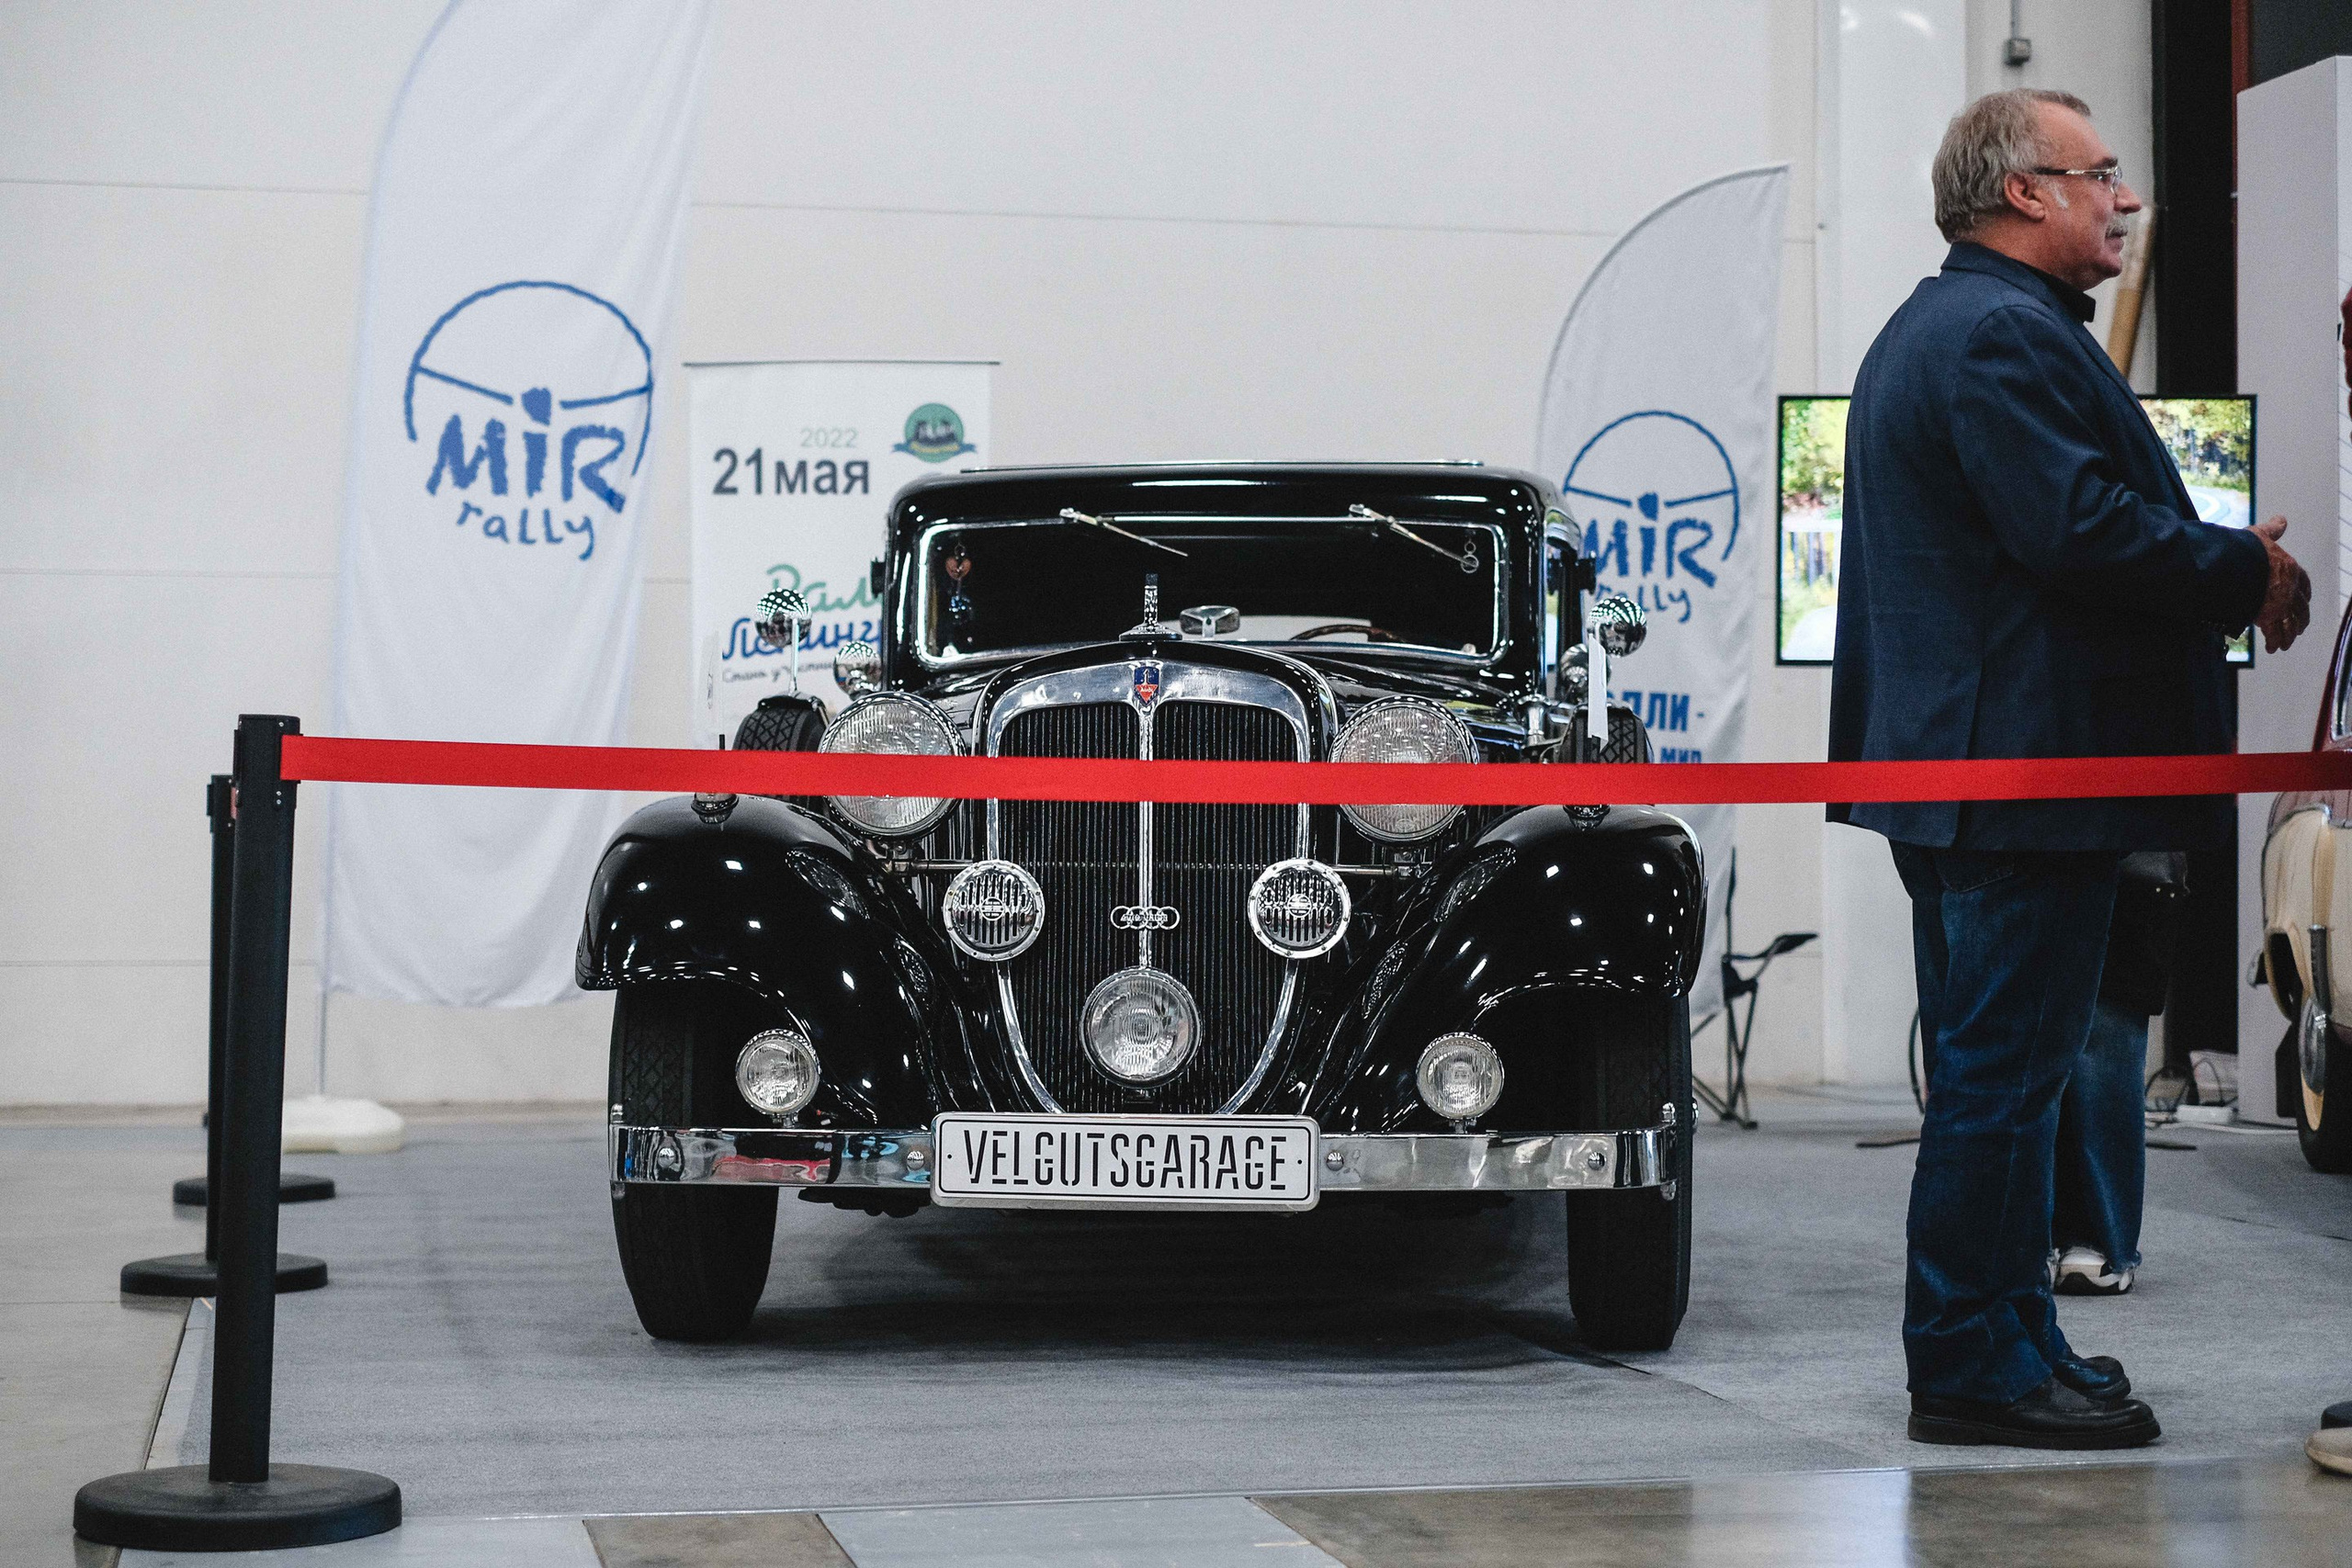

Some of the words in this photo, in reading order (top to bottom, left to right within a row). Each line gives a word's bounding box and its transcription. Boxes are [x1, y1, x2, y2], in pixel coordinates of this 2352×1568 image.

[800, 428, 858, 448] 2022
[457, 501, 594, 560] rally
[766, 564, 882, 613] Рал
[964, 1130, 1286, 1190] VELGUTSGARAGE
